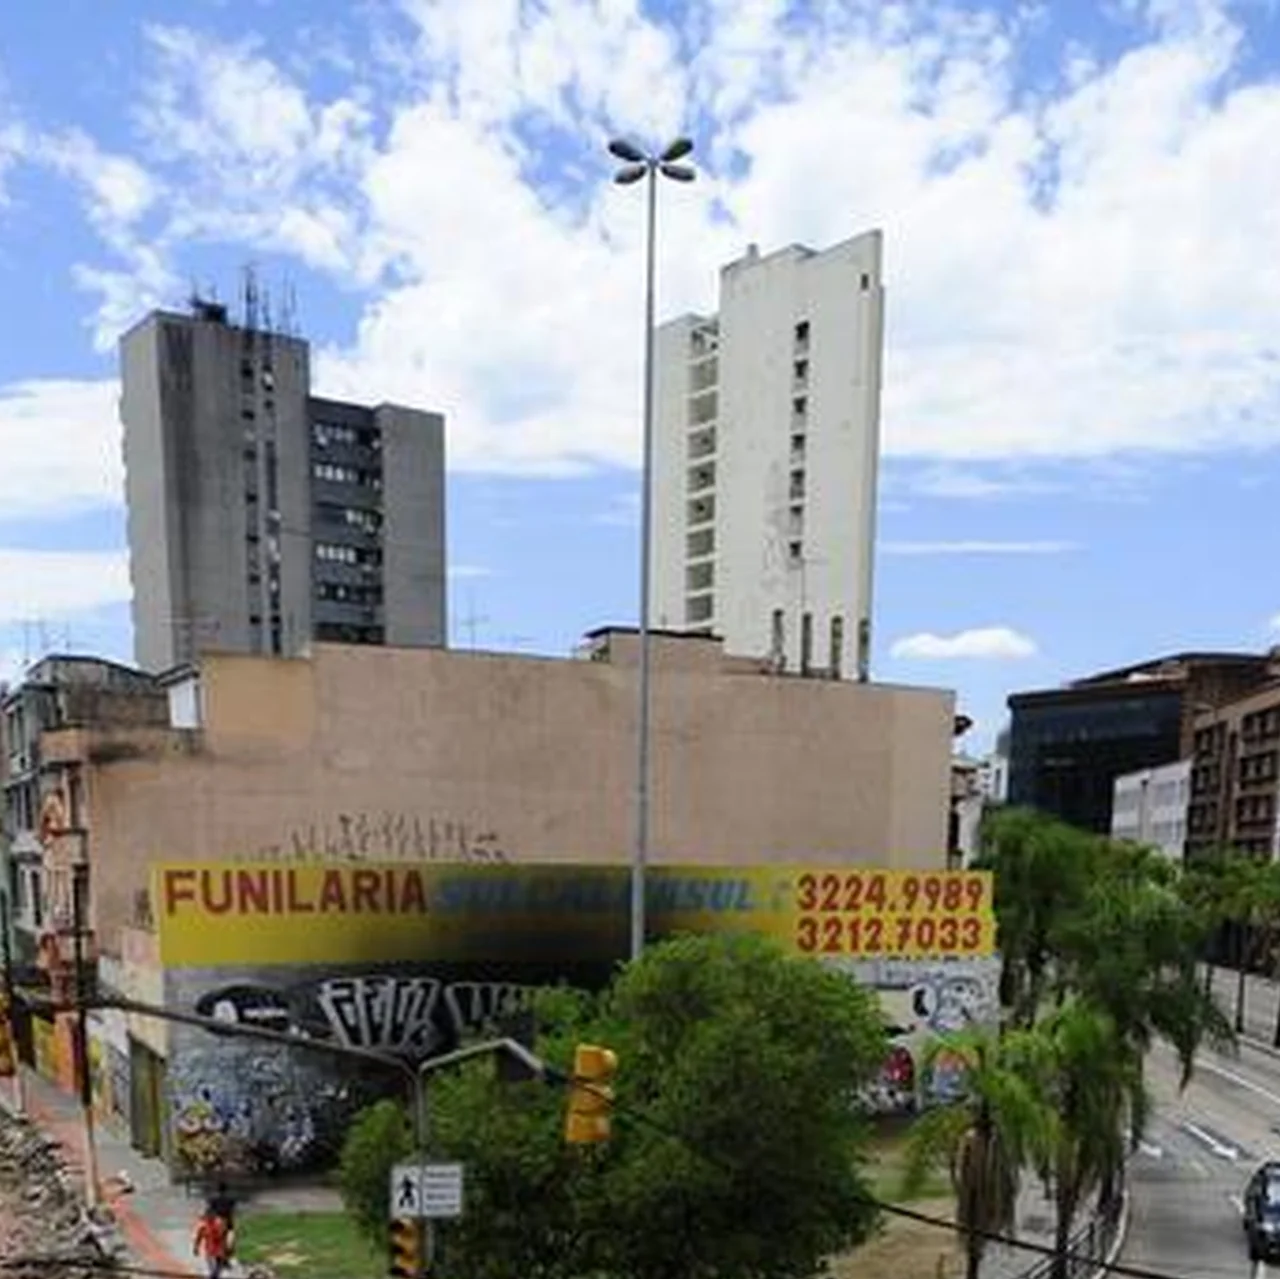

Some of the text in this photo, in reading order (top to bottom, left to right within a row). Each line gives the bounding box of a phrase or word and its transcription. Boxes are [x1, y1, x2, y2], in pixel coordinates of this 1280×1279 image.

[164, 868, 428, 914] FUNILARIA
[797, 874, 983, 912] 3224.9989
[797, 916, 982, 952] 3212.7033
